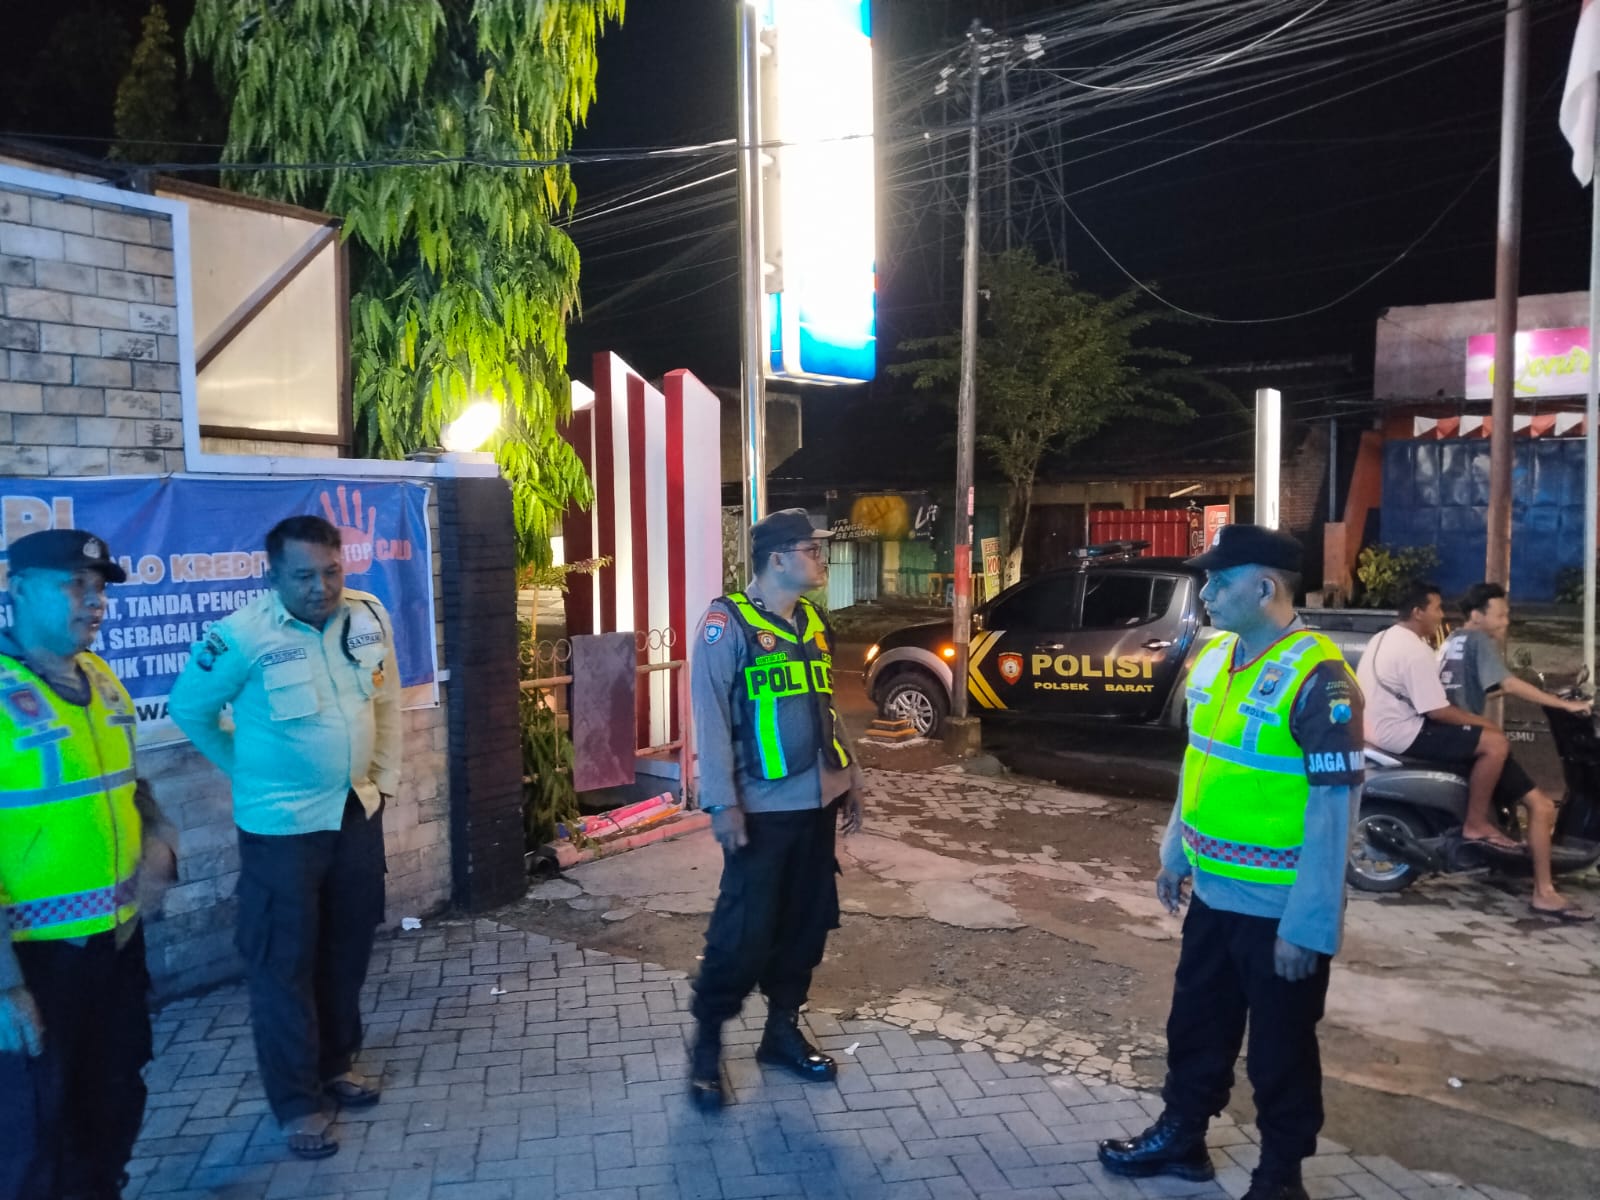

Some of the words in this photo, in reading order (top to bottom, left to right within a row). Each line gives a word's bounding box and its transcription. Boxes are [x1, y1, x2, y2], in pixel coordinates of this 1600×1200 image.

[341, 542, 372, 562] TOP
[126, 593, 194, 619] TANDA
[108, 622, 198, 650] SEBAGAI
[1031, 654, 1153, 679] POLISI
[1033, 681, 1089, 692] POLSEK
[1104, 683, 1155, 693] BARAT
[1308, 751, 1347, 774] JAGA
